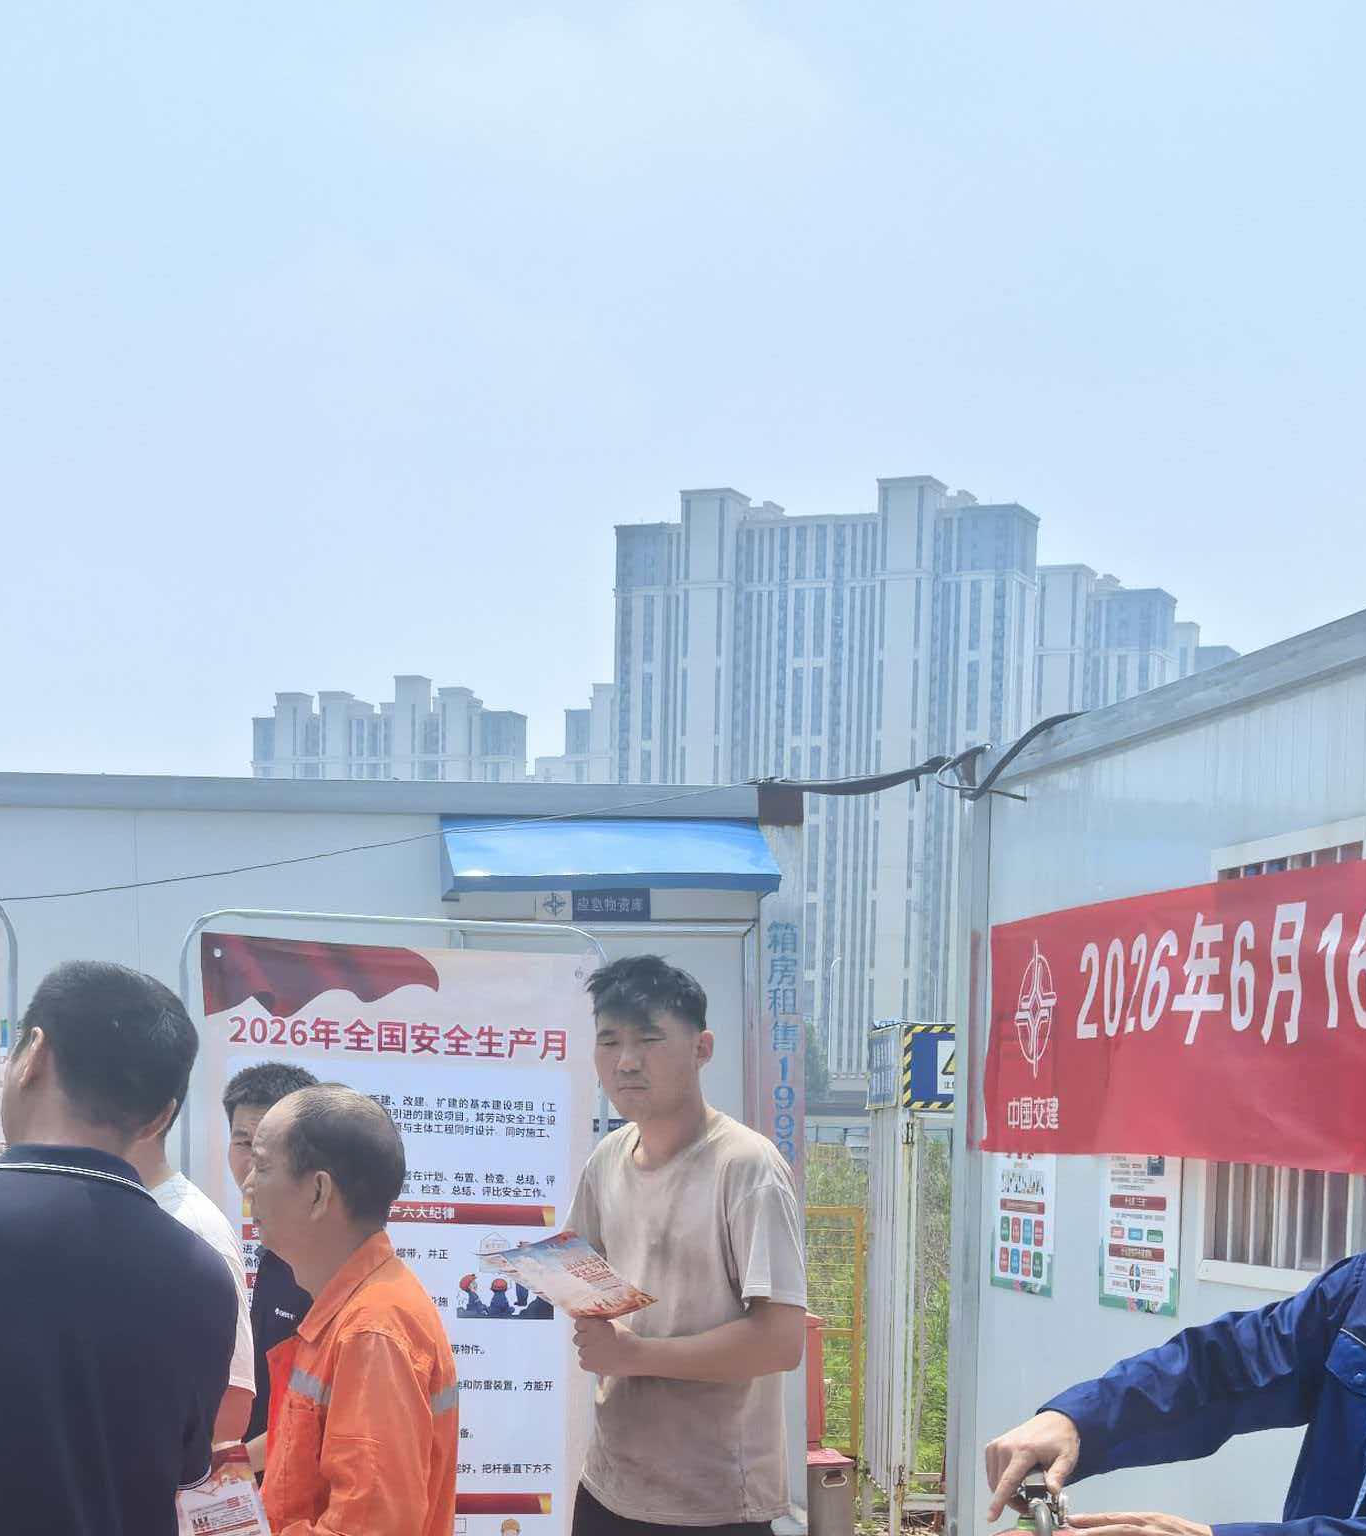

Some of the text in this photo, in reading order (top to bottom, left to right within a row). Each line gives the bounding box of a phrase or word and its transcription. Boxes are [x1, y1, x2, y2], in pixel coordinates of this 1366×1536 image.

[228, 1015, 568, 1062] 2026年全国安全生产月
[1007, 1096, 1059, 1131] 中国交建
